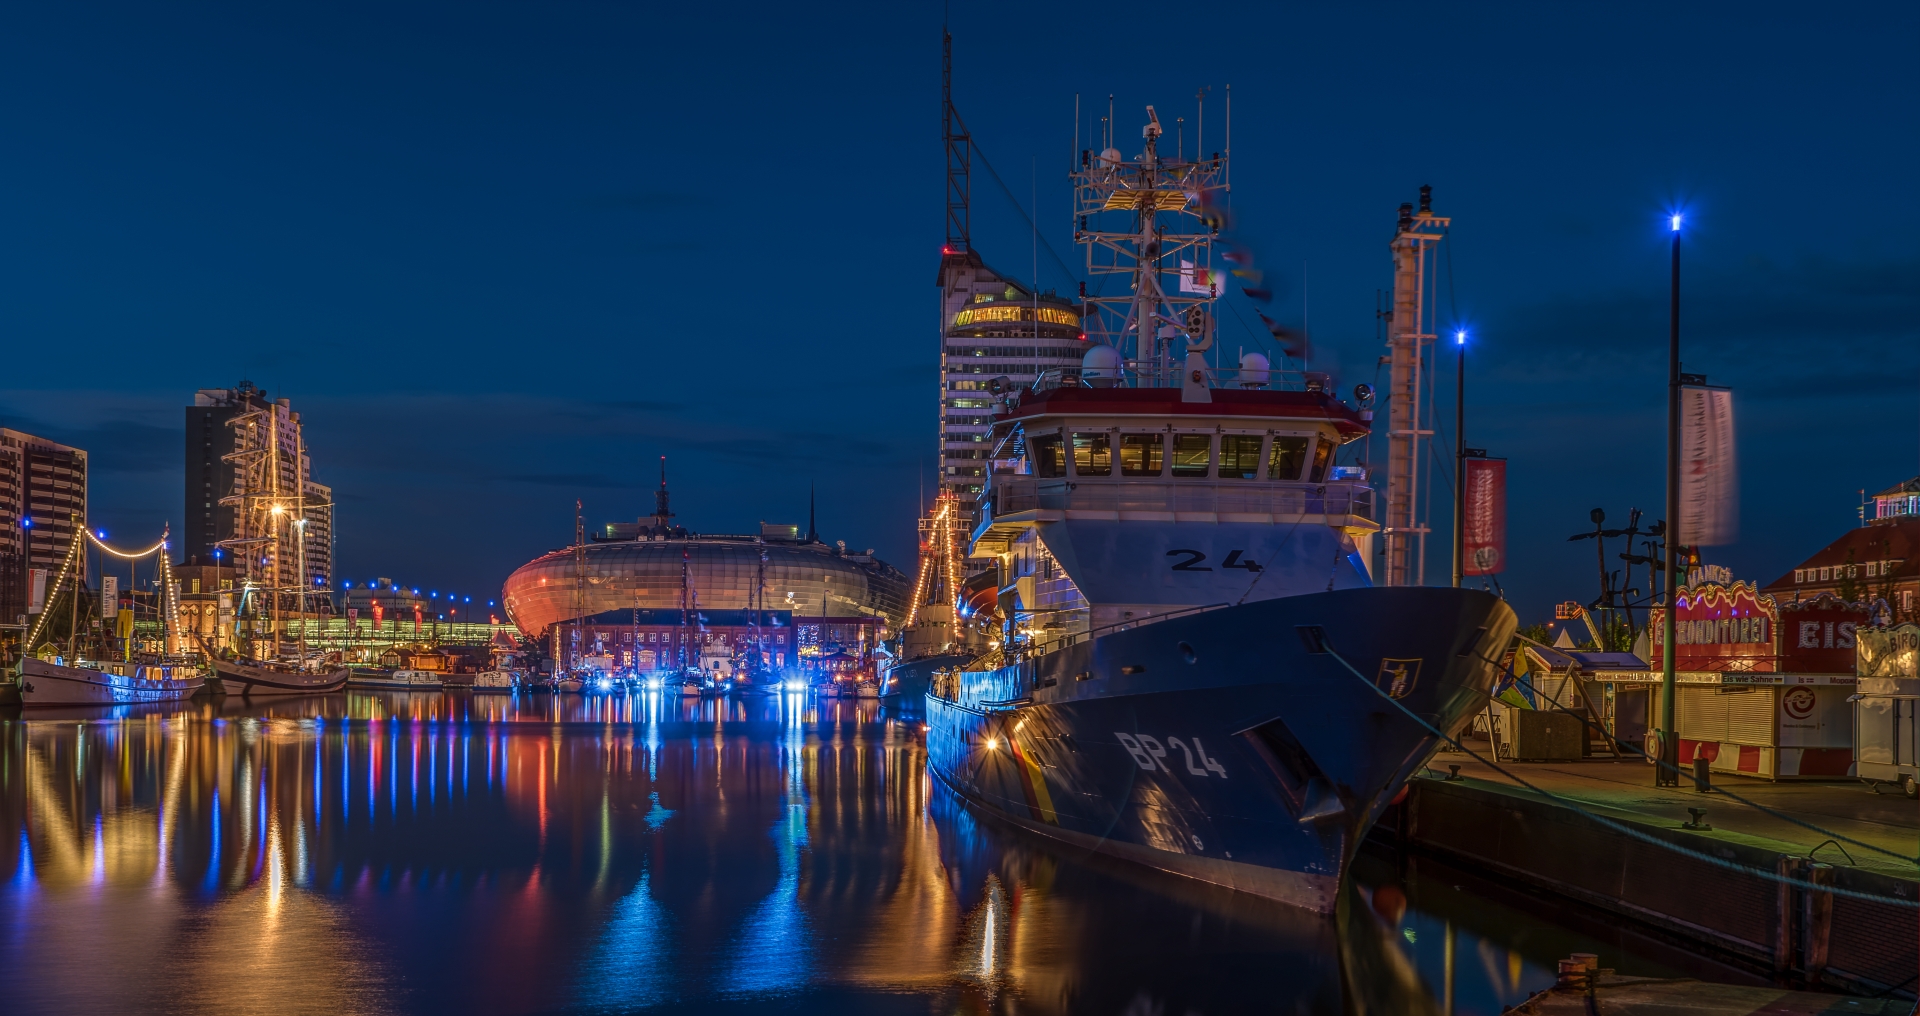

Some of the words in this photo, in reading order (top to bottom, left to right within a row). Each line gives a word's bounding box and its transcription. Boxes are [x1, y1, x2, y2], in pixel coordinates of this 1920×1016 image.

[1166, 549, 1265, 572] 24
[1655, 616, 1768, 646] EKONDITOREI
[1797, 620, 1857, 649] EIS
[1722, 675, 1734, 683] Eis
[1735, 675, 1749, 683] wie
[1750, 675, 1774, 684] Sahne
[1114, 732, 1170, 773] BP
[1168, 736, 1228, 779] 24
